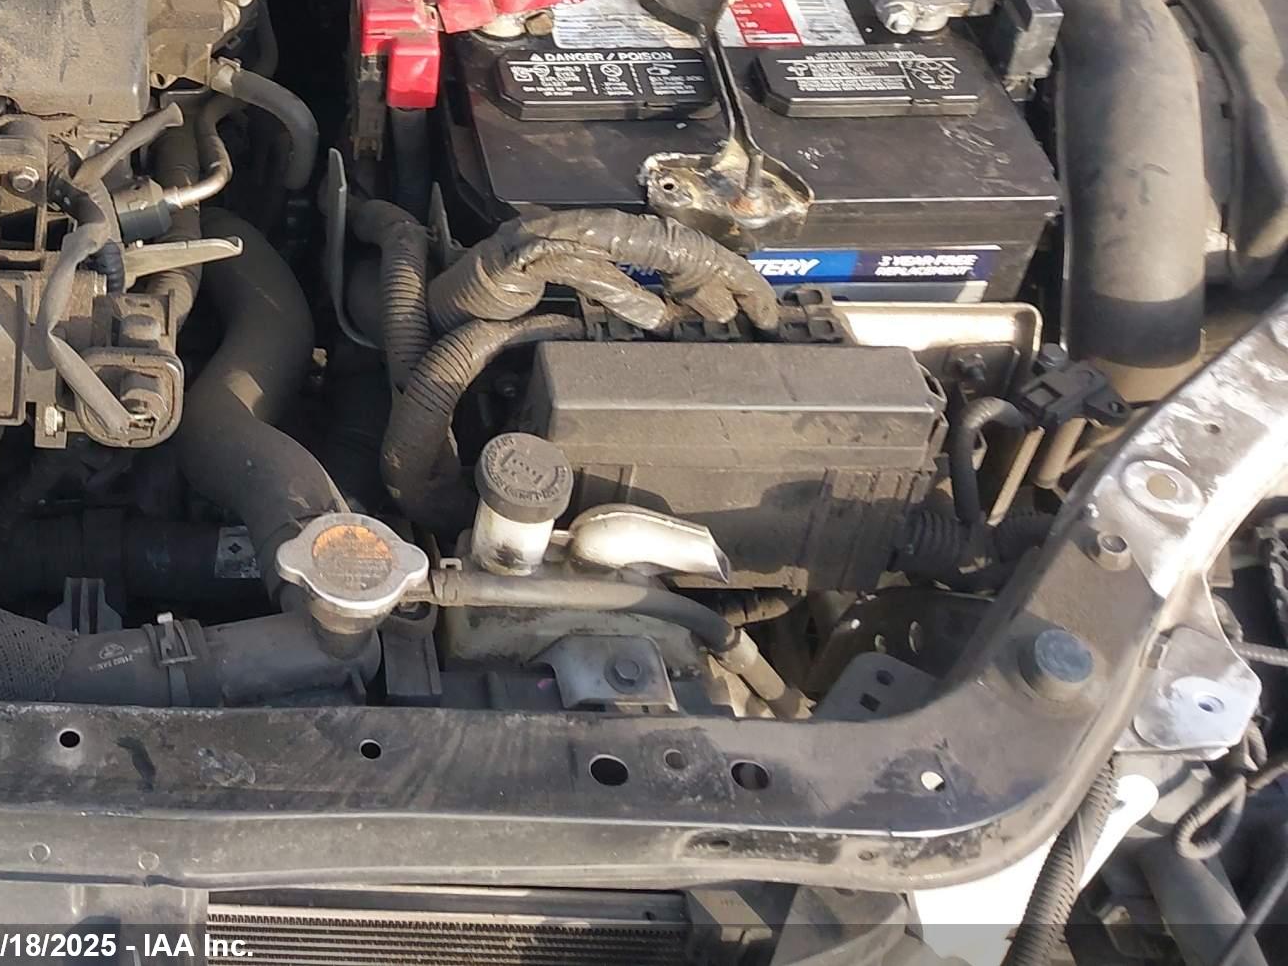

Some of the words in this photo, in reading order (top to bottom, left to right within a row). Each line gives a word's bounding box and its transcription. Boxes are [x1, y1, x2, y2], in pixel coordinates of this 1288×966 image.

[544, 52, 604, 62] DANGER
[617, 51, 674, 61] POISON
[748, 258, 821, 276] TERY
[874, 265, 974, 277] REPLACEMENT
